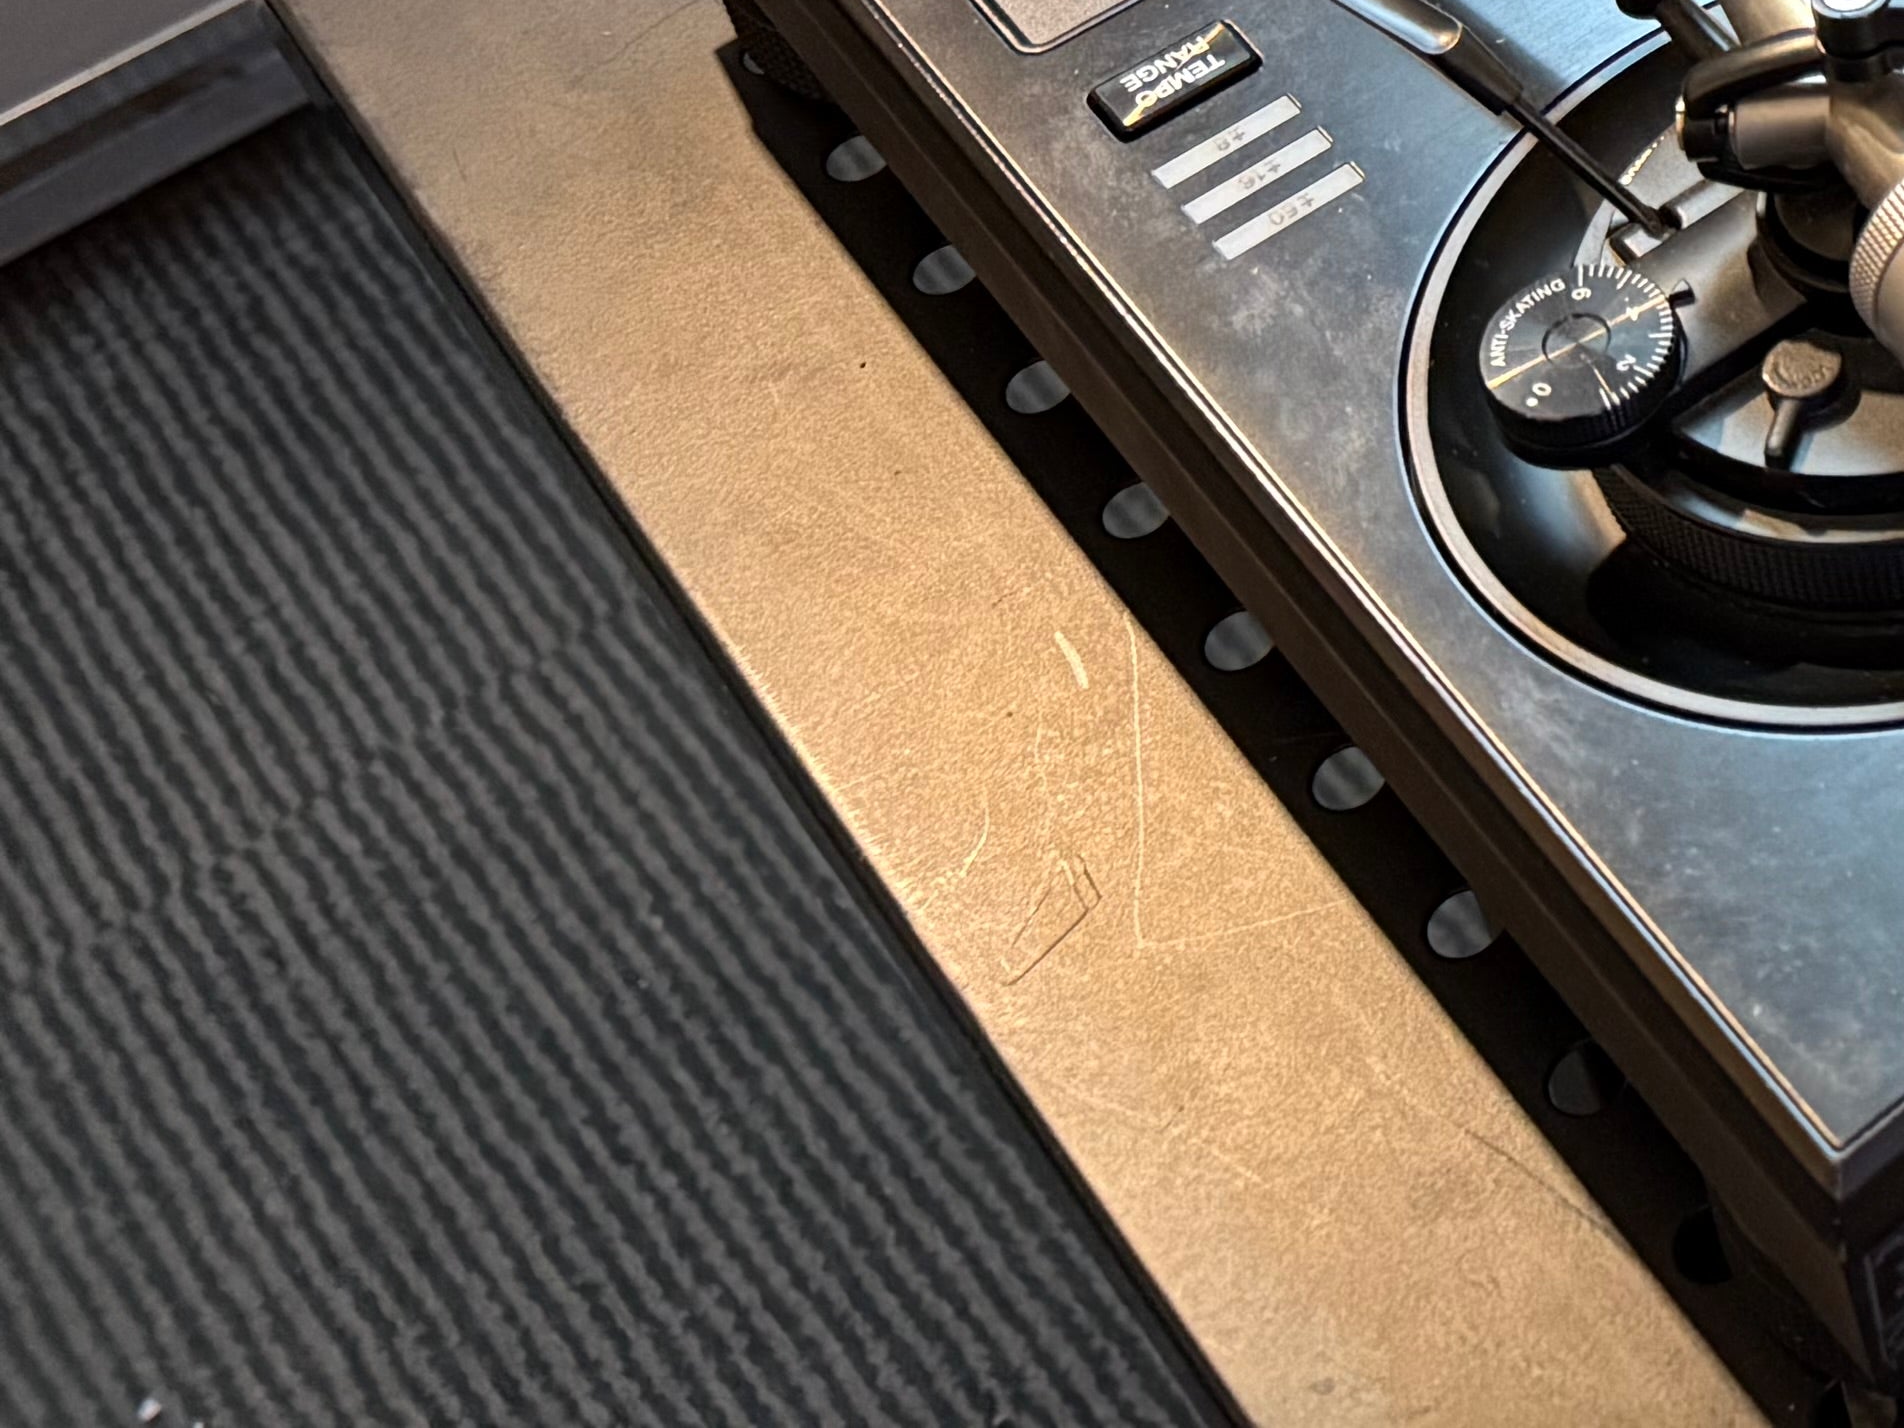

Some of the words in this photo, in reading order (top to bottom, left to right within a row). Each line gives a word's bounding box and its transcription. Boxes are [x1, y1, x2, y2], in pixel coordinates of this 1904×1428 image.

[1119, 35, 1210, 93] RANGE
[1135, 53, 1226, 108] TEMPO
[1571, 288, 1592, 301] 6
[1490, 278, 1566, 367] ANTI-SKATING
[1616, 353, 1637, 372] 2
[1532, 382, 1552, 396] 0
